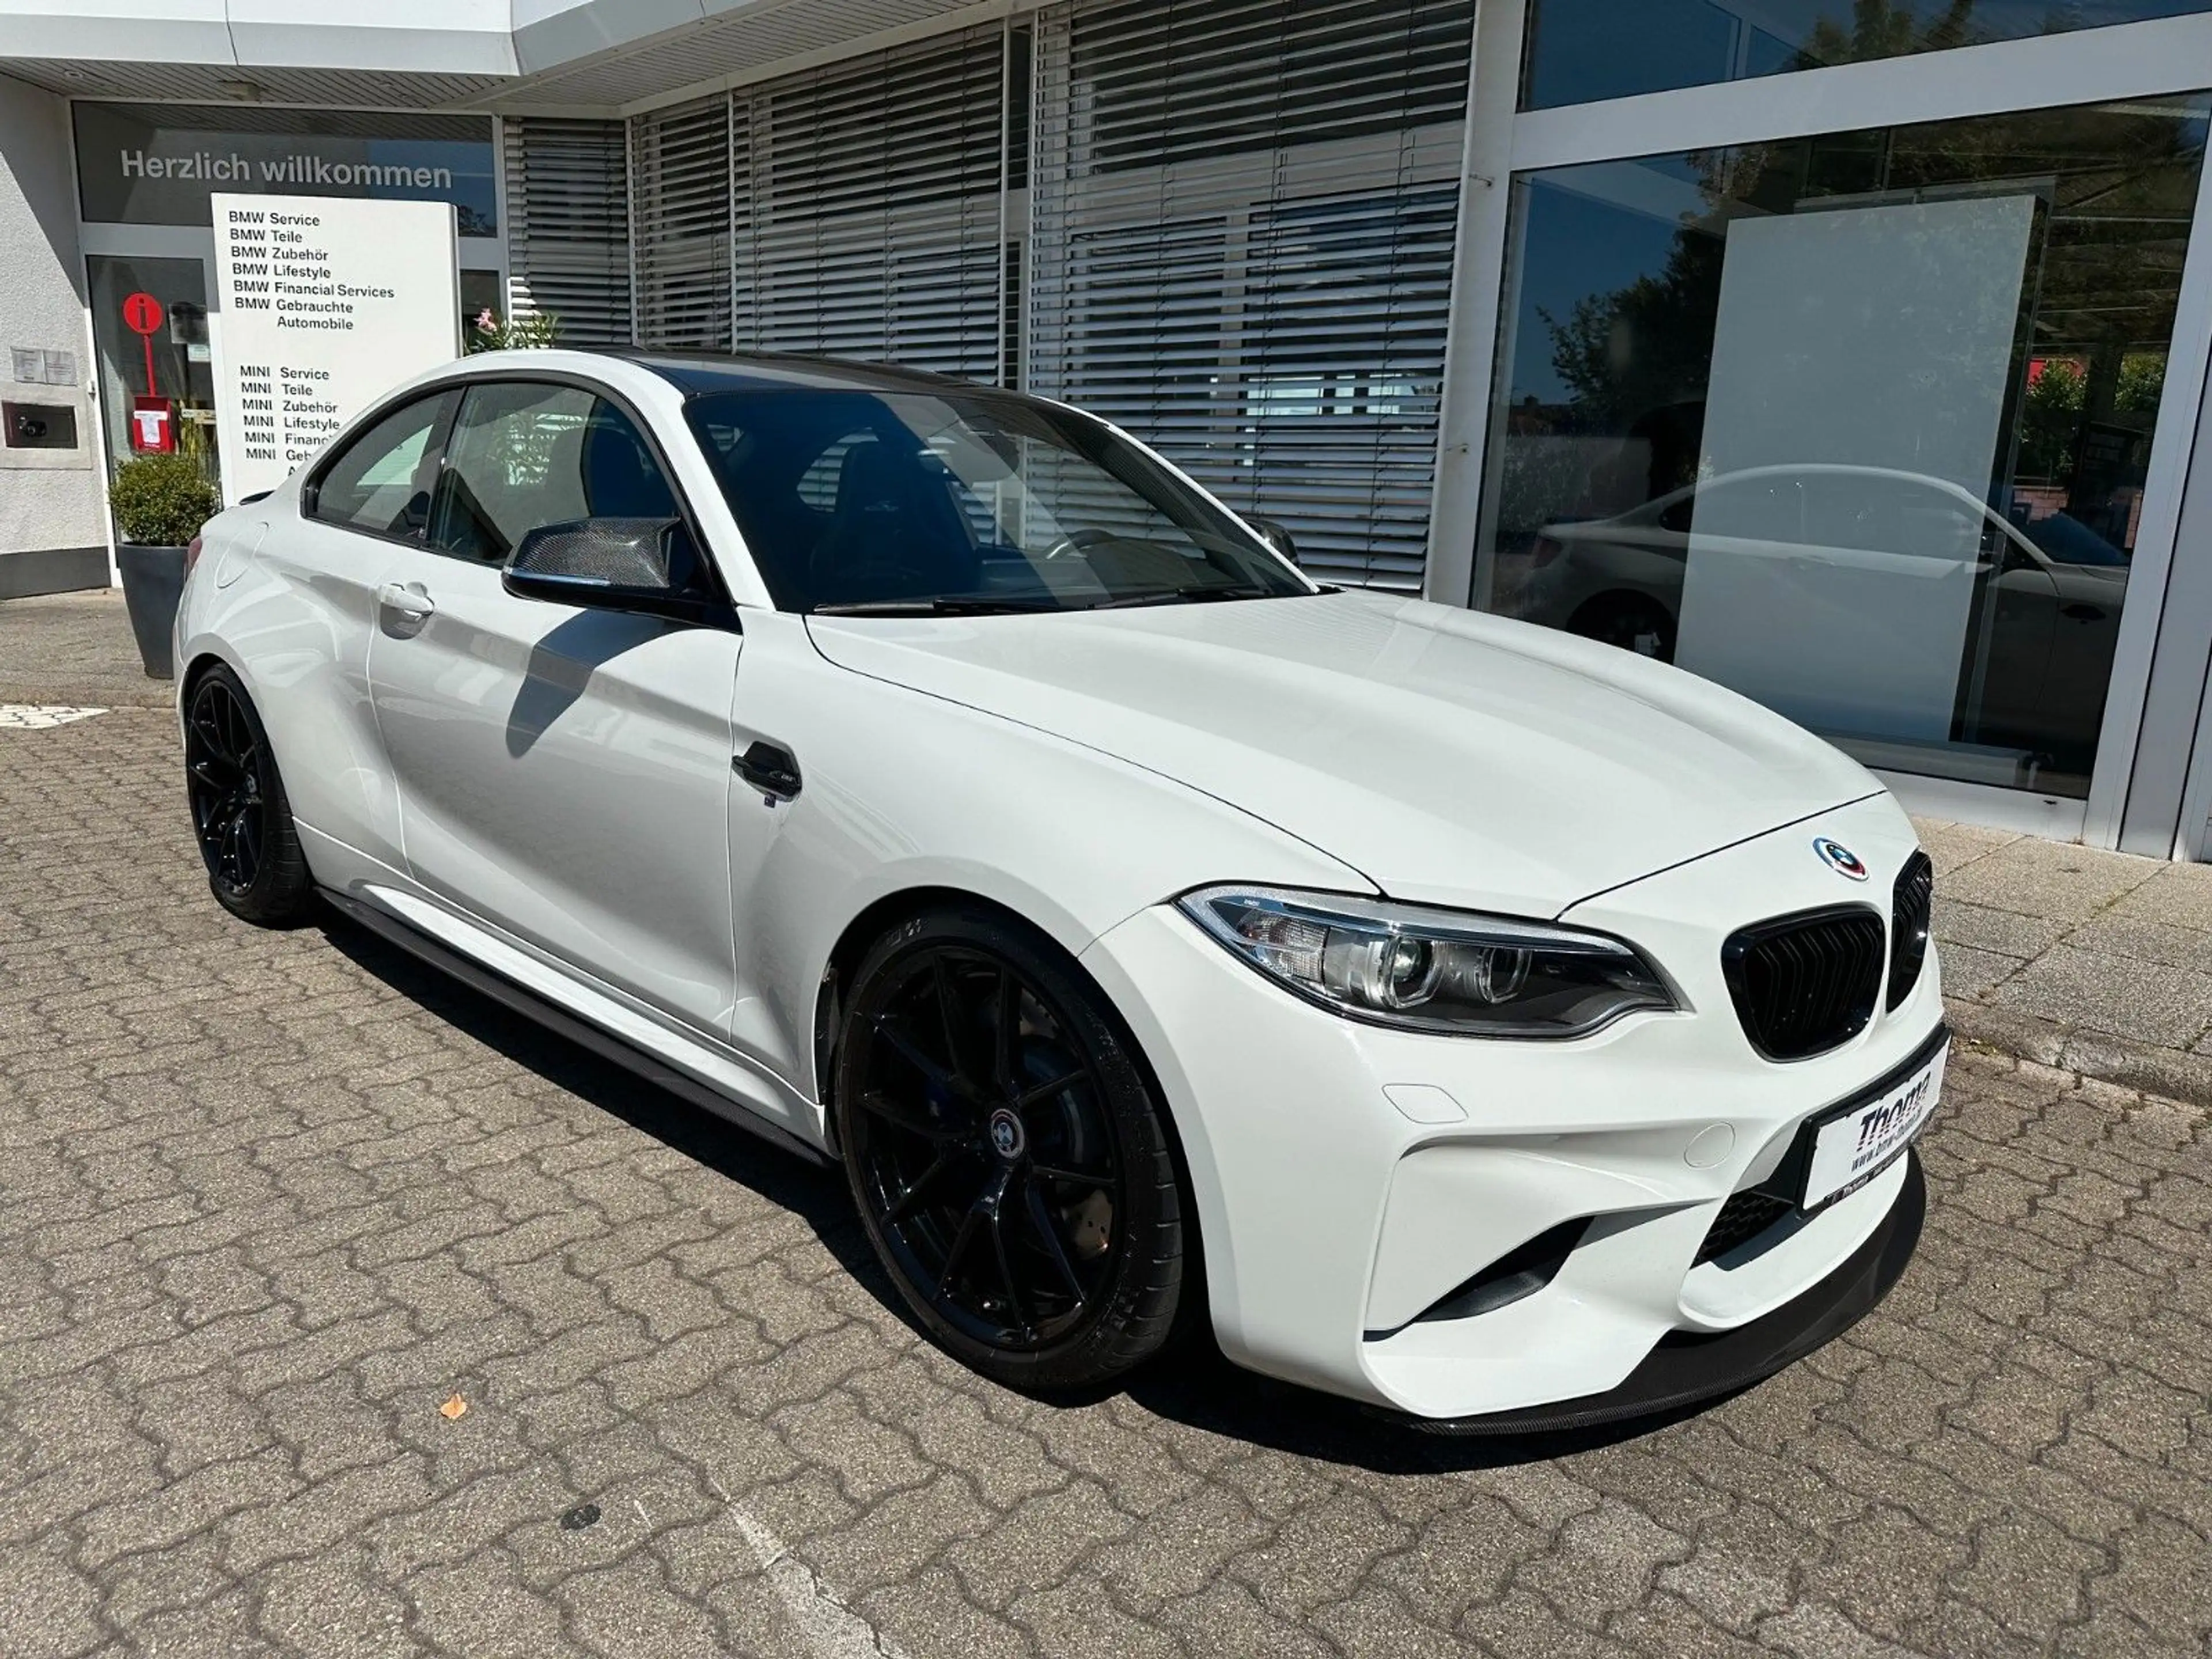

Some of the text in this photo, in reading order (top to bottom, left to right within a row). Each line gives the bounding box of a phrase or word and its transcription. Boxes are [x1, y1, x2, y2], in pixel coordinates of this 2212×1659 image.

[120, 150, 452, 189] Herzlich willkommen
[229, 210, 320, 226] BMW Service
[230, 228, 302, 243] BMW Teile
[231, 245, 328, 261] BMW Zubehör
[232, 262, 331, 281] BMW Lifestyle
[233, 279, 395, 298] BMW Financial Services
[234, 297, 353, 313] BMW Gebrauchte
[277, 316, 354, 330] Automobile
[240, 365, 329, 380] MINI Service
[241, 382, 313, 396] MINI Teile
[243, 398, 338, 413] MINI Zubehör
[243, 415, 340, 432] MINI Lifestyle
[244, 431, 332, 445] MINI Financ
[246, 448, 276, 460] MINI
